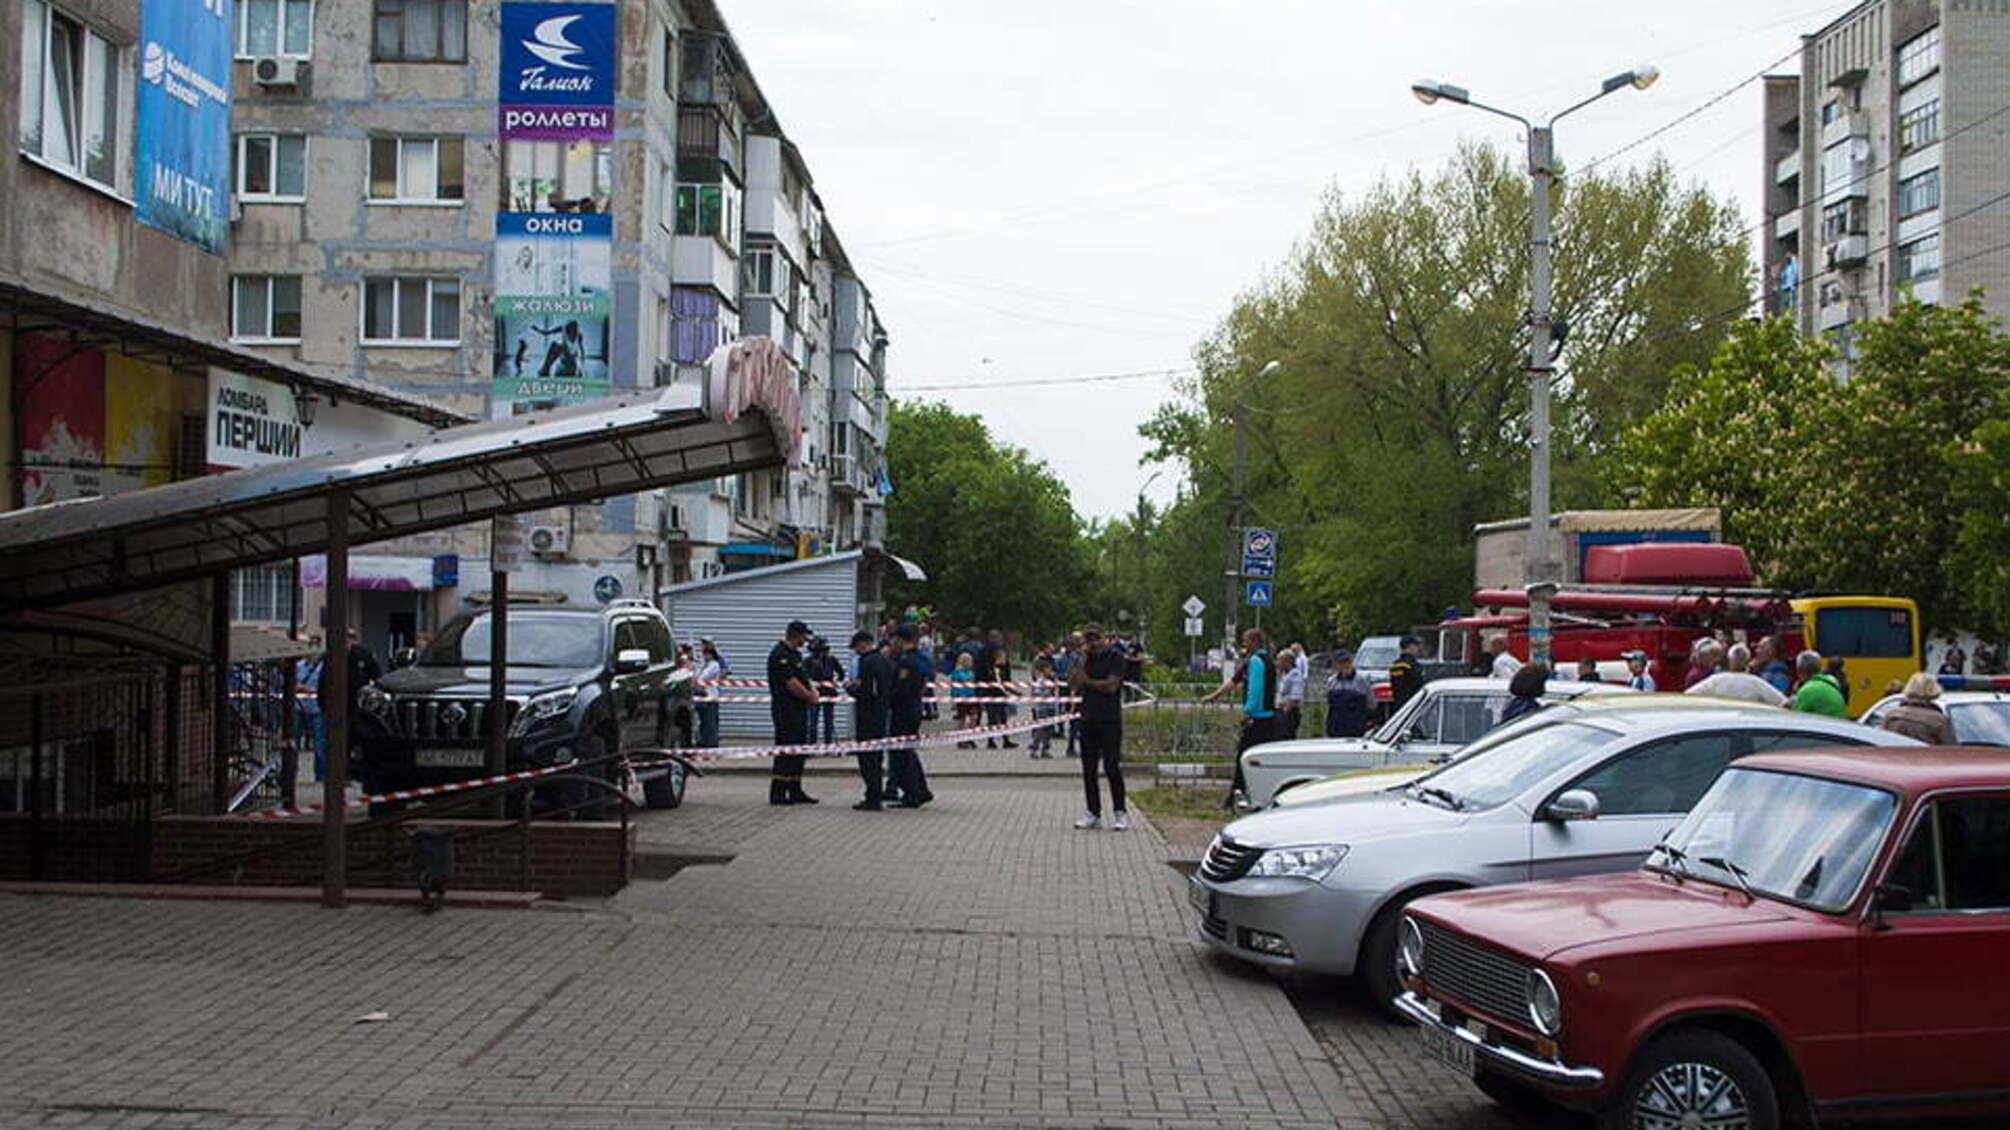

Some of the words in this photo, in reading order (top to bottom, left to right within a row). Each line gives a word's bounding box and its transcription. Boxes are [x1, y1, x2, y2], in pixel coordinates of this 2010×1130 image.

[519, 66, 594, 91] Галион
[505, 111, 607, 131] роллеты
[154, 162, 182, 208] МИ
[184, 176, 214, 219] ТУТ
[525, 218, 583, 233] окна
[511, 298, 595, 313] жалюзи
[518, 381, 583, 395] двери
[217, 386, 268, 415] ЛОМБАРД
[216, 411, 301, 458] ПЕРШИЙ
